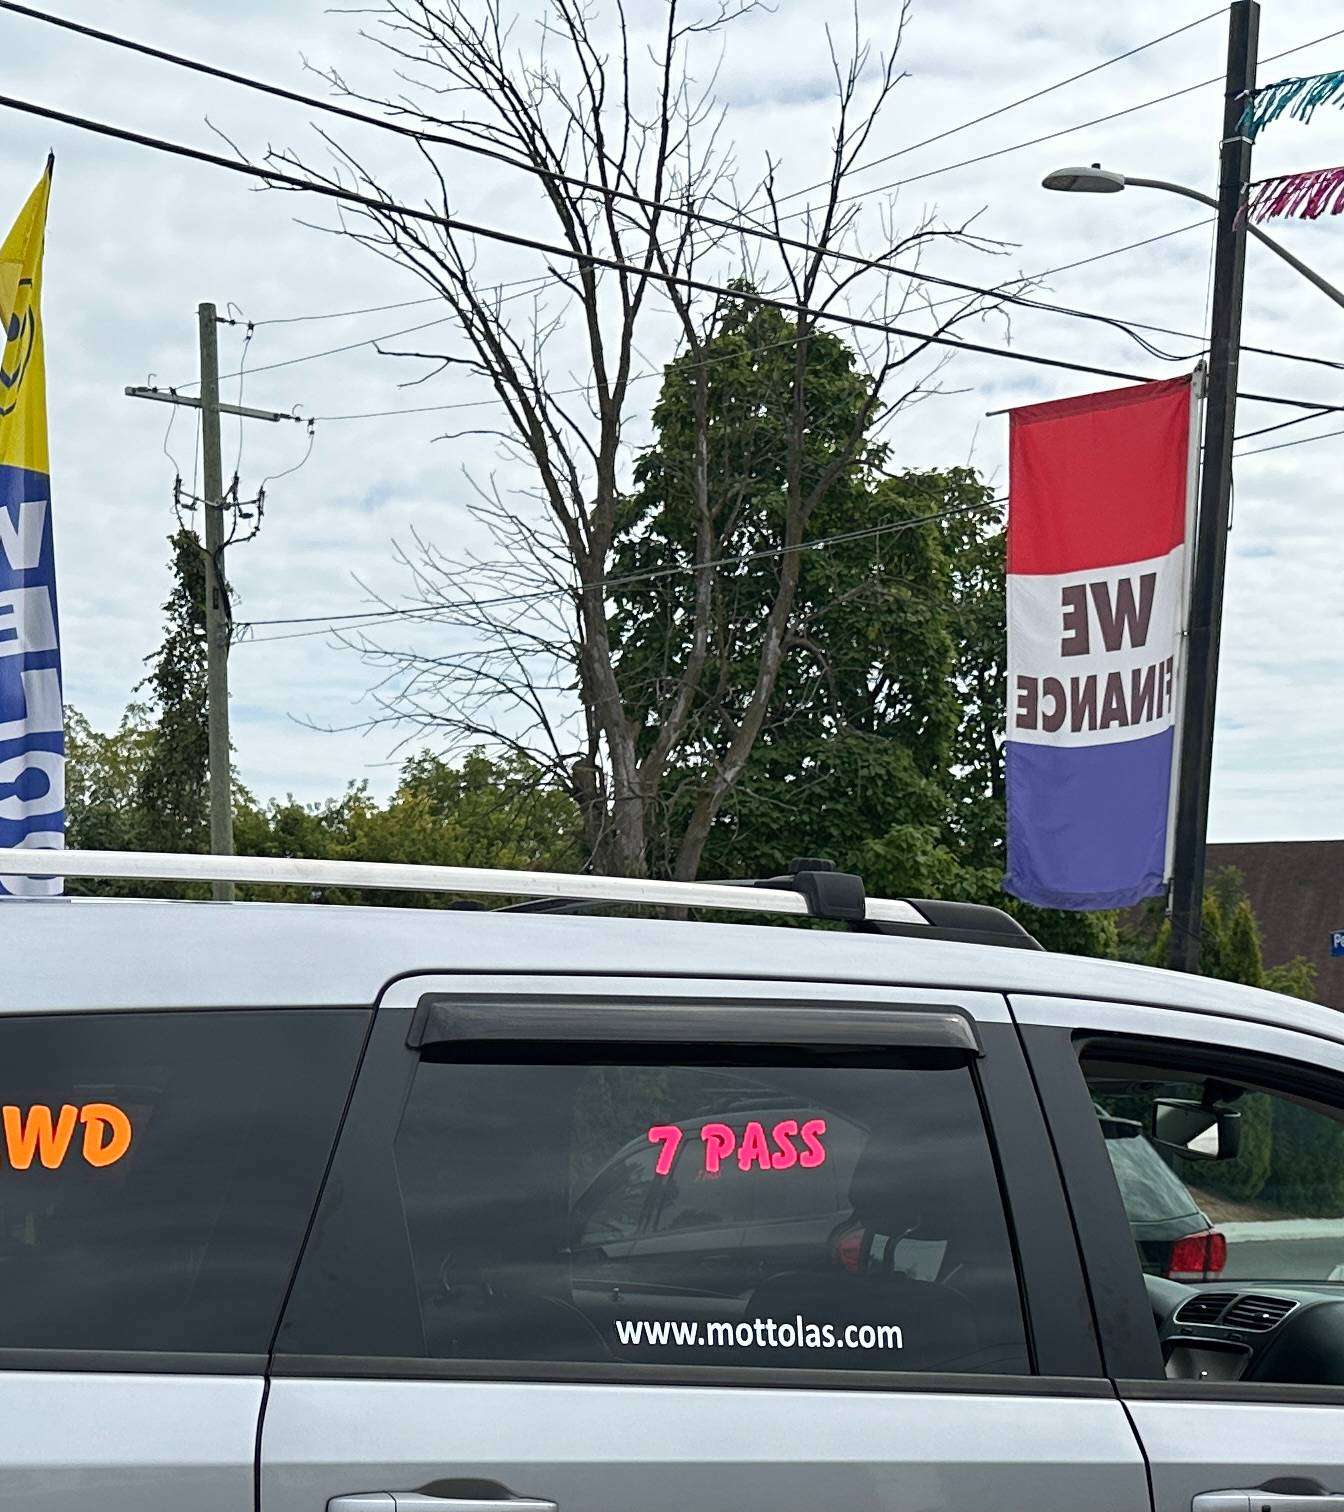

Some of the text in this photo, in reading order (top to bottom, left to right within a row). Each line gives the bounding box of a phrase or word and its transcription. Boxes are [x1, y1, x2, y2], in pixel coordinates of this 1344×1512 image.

[647, 1118, 827, 1176] 7 PASS
[616, 1315, 904, 1349] www.mottolas.com
